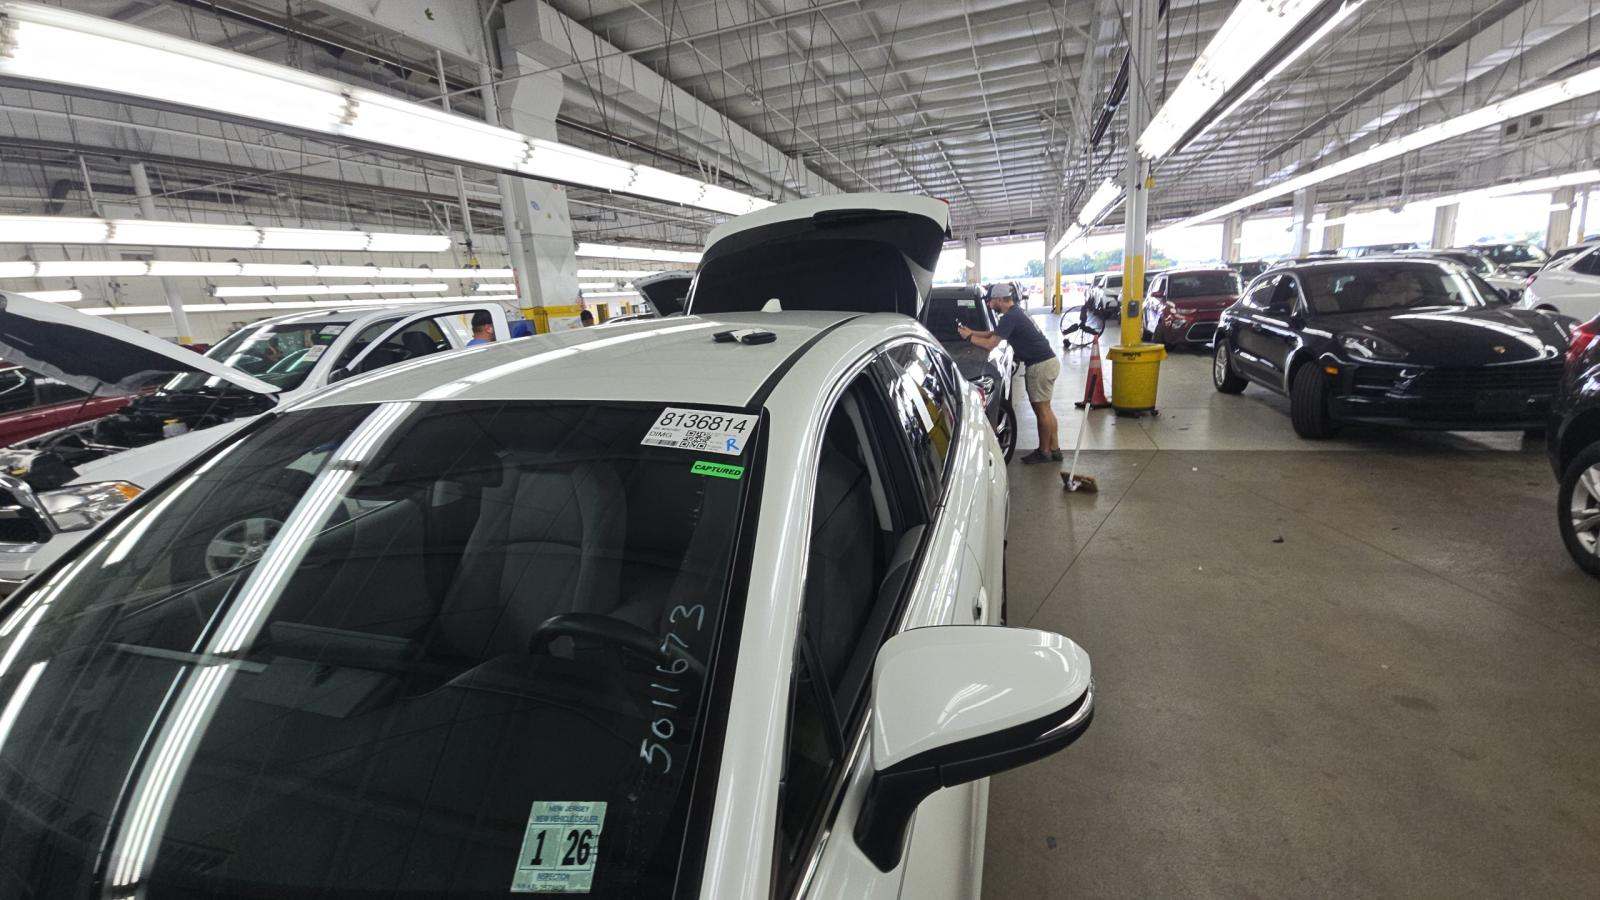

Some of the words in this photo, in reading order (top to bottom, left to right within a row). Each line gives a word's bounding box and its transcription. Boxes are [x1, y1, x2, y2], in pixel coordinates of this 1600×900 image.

[660, 412, 748, 434] 8136814
[726, 438, 740, 451] R
[694, 464, 742, 476] CAPTURED
[530, 829, 547, 866] 1
[561, 828, 593, 866] 26
